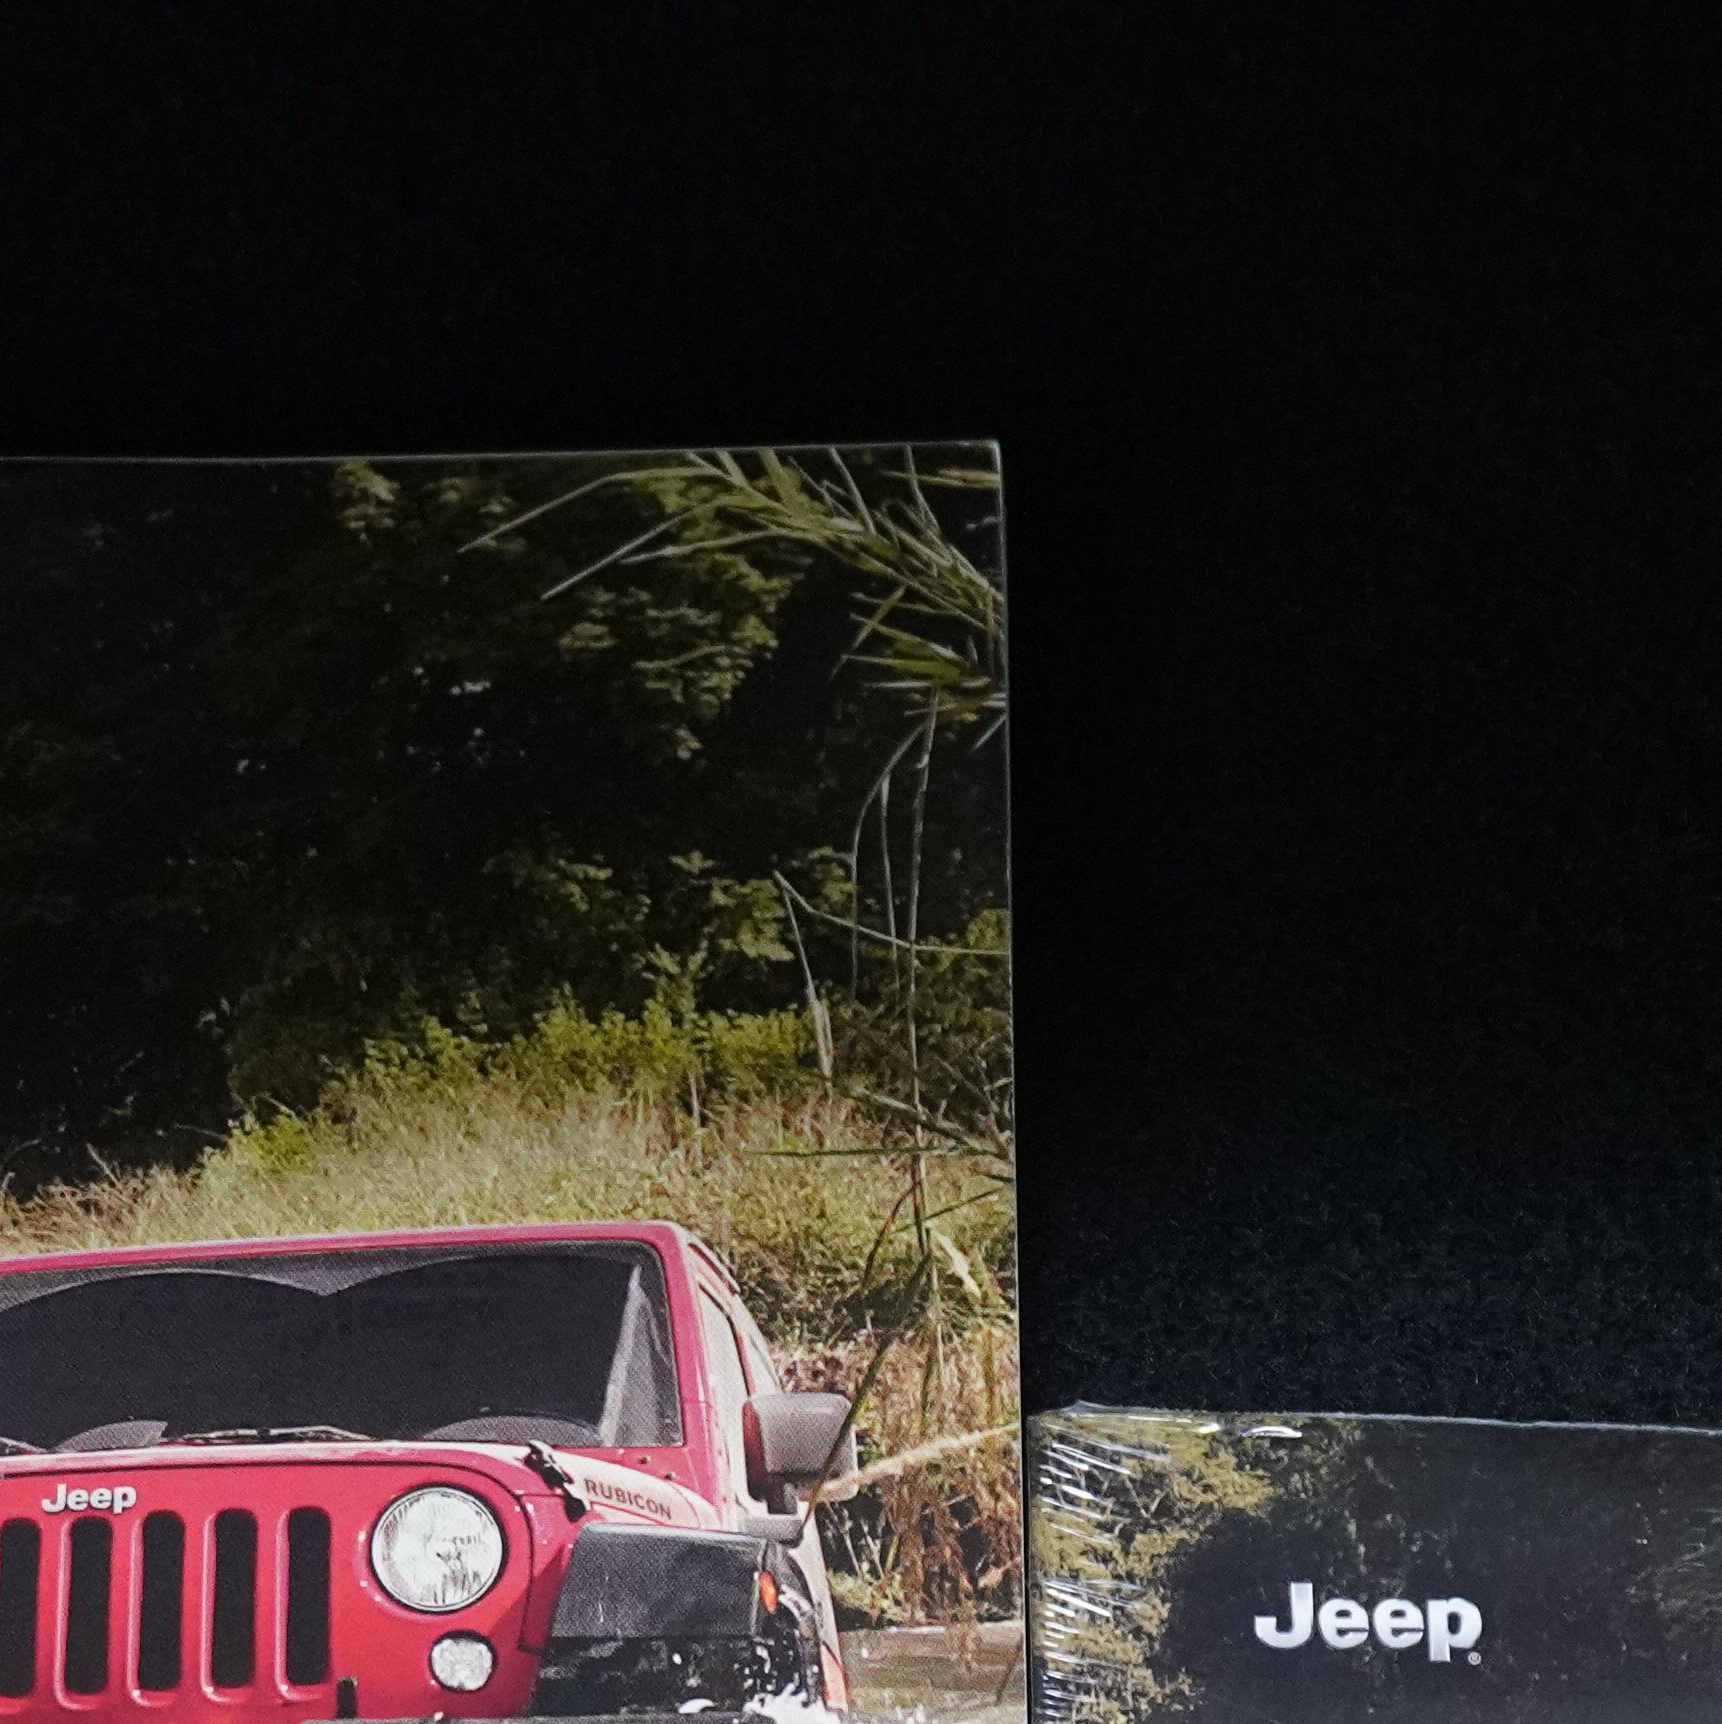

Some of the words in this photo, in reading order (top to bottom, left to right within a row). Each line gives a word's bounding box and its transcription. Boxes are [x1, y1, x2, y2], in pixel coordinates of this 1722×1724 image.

[41, 1483, 137, 1514] Jeep
[583, 1478, 671, 1520] RUBICON
[1254, 1582, 1482, 1662] Jeep
